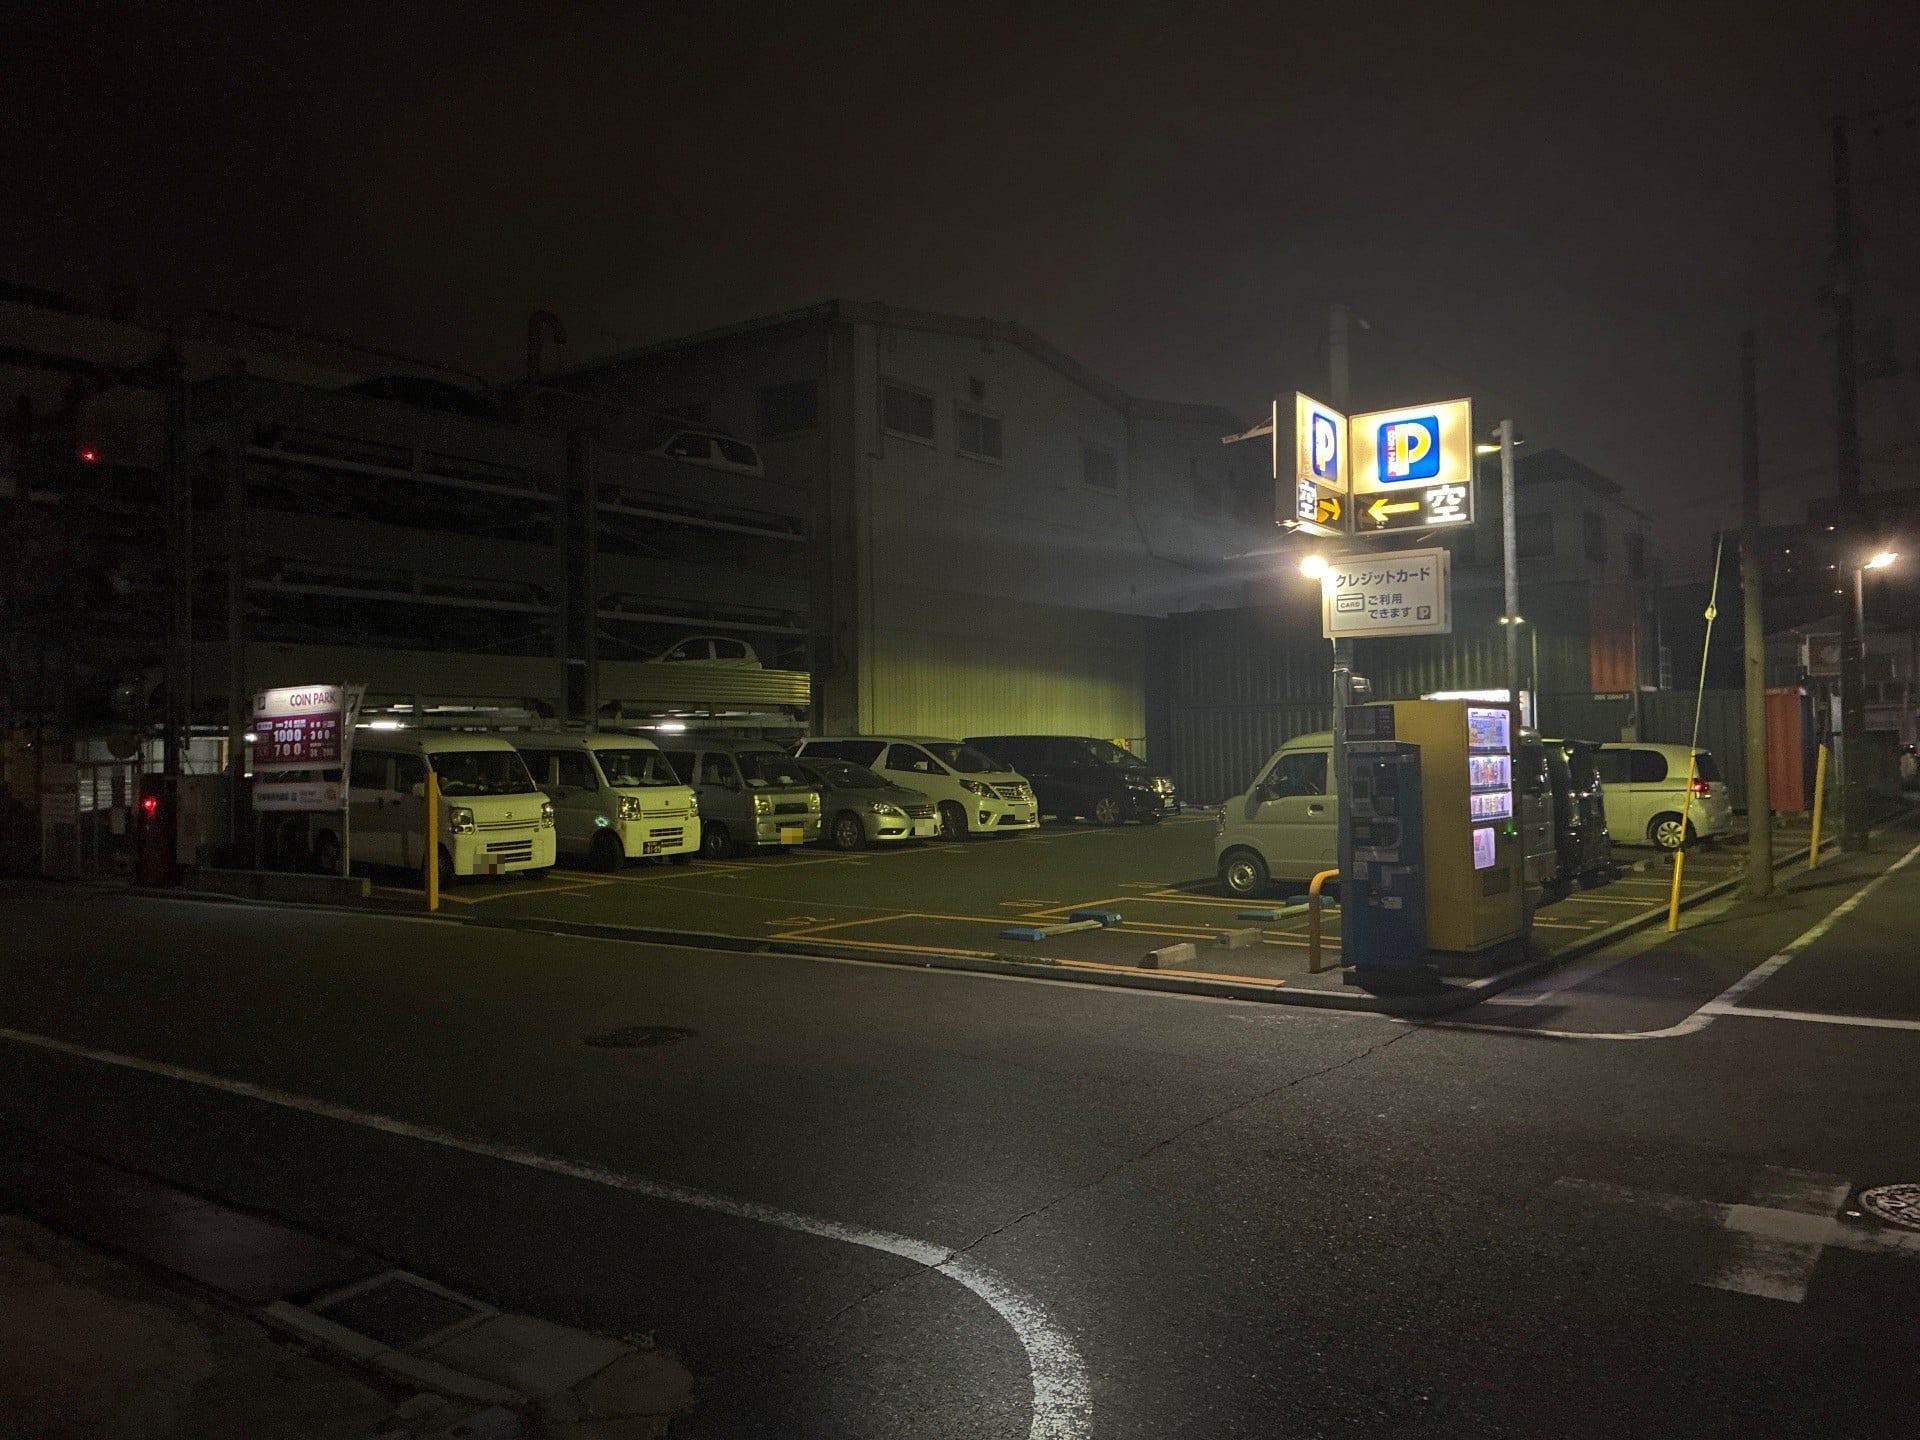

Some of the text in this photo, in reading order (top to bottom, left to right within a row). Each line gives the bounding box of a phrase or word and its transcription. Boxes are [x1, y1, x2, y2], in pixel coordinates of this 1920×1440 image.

[1426, 484, 1467, 524] 空
[1336, 567, 1430, 588] クレジットカード
[1368, 593, 1402, 606] ご利用
[1368, 606, 1411, 619] できます
[290, 691, 336, 707] COIN PARK
